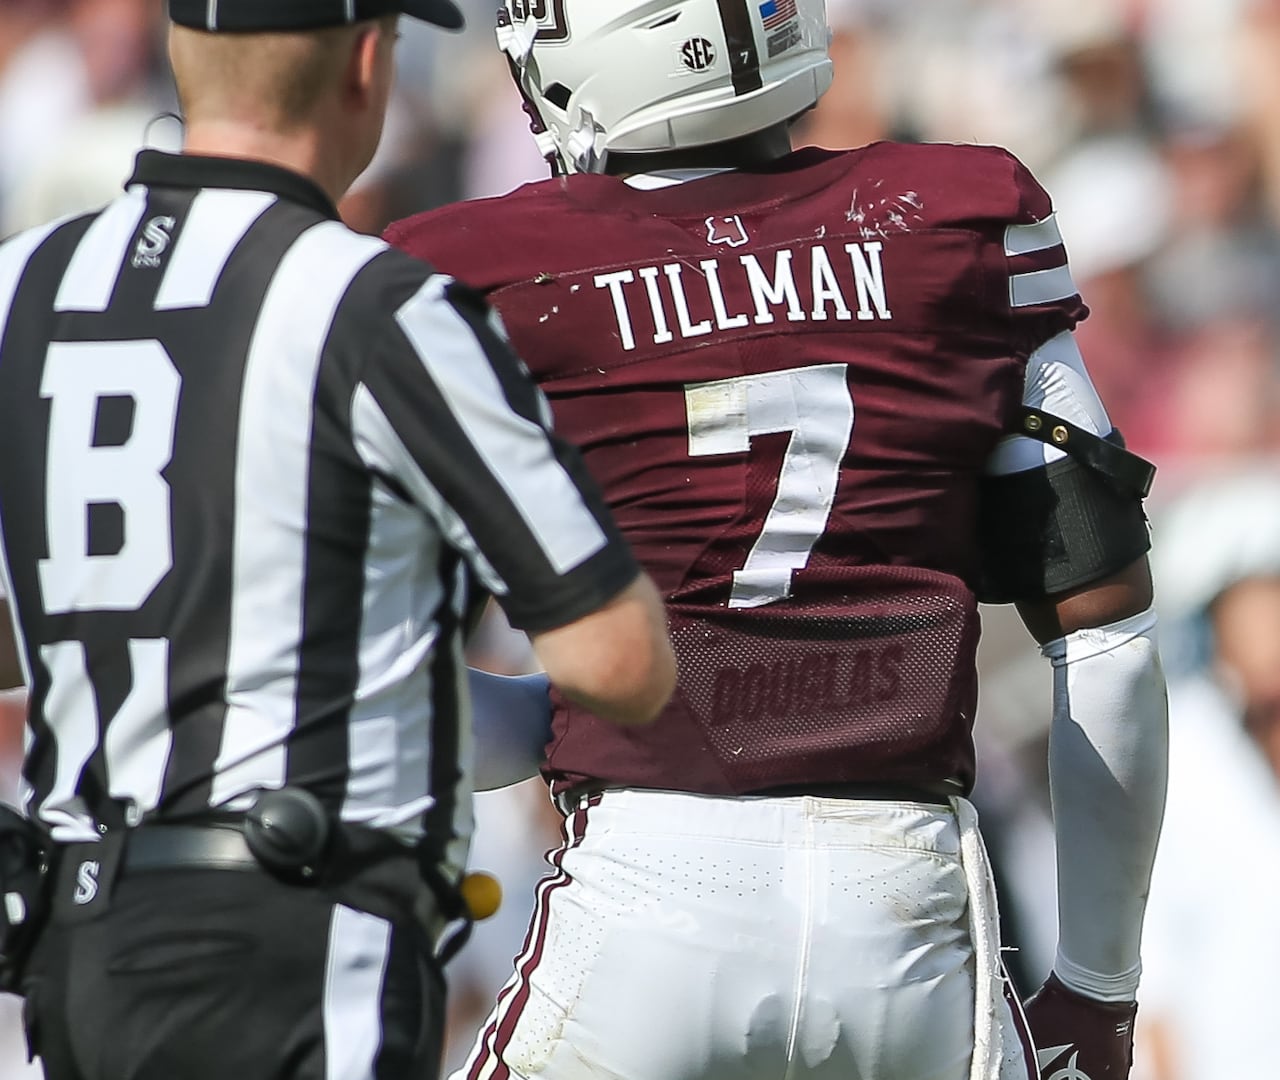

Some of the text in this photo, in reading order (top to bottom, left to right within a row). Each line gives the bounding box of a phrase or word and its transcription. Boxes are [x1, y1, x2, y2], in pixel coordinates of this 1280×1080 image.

[681, 38, 715, 69] SEC
[740, 51, 749, 64] 7
[594, 242, 893, 350] TILLMAN
[36, 338, 183, 615] B
[684, 363, 854, 609] 7
[710, 642, 905, 727] DOUGLAS
[73, 860, 100, 905] S
